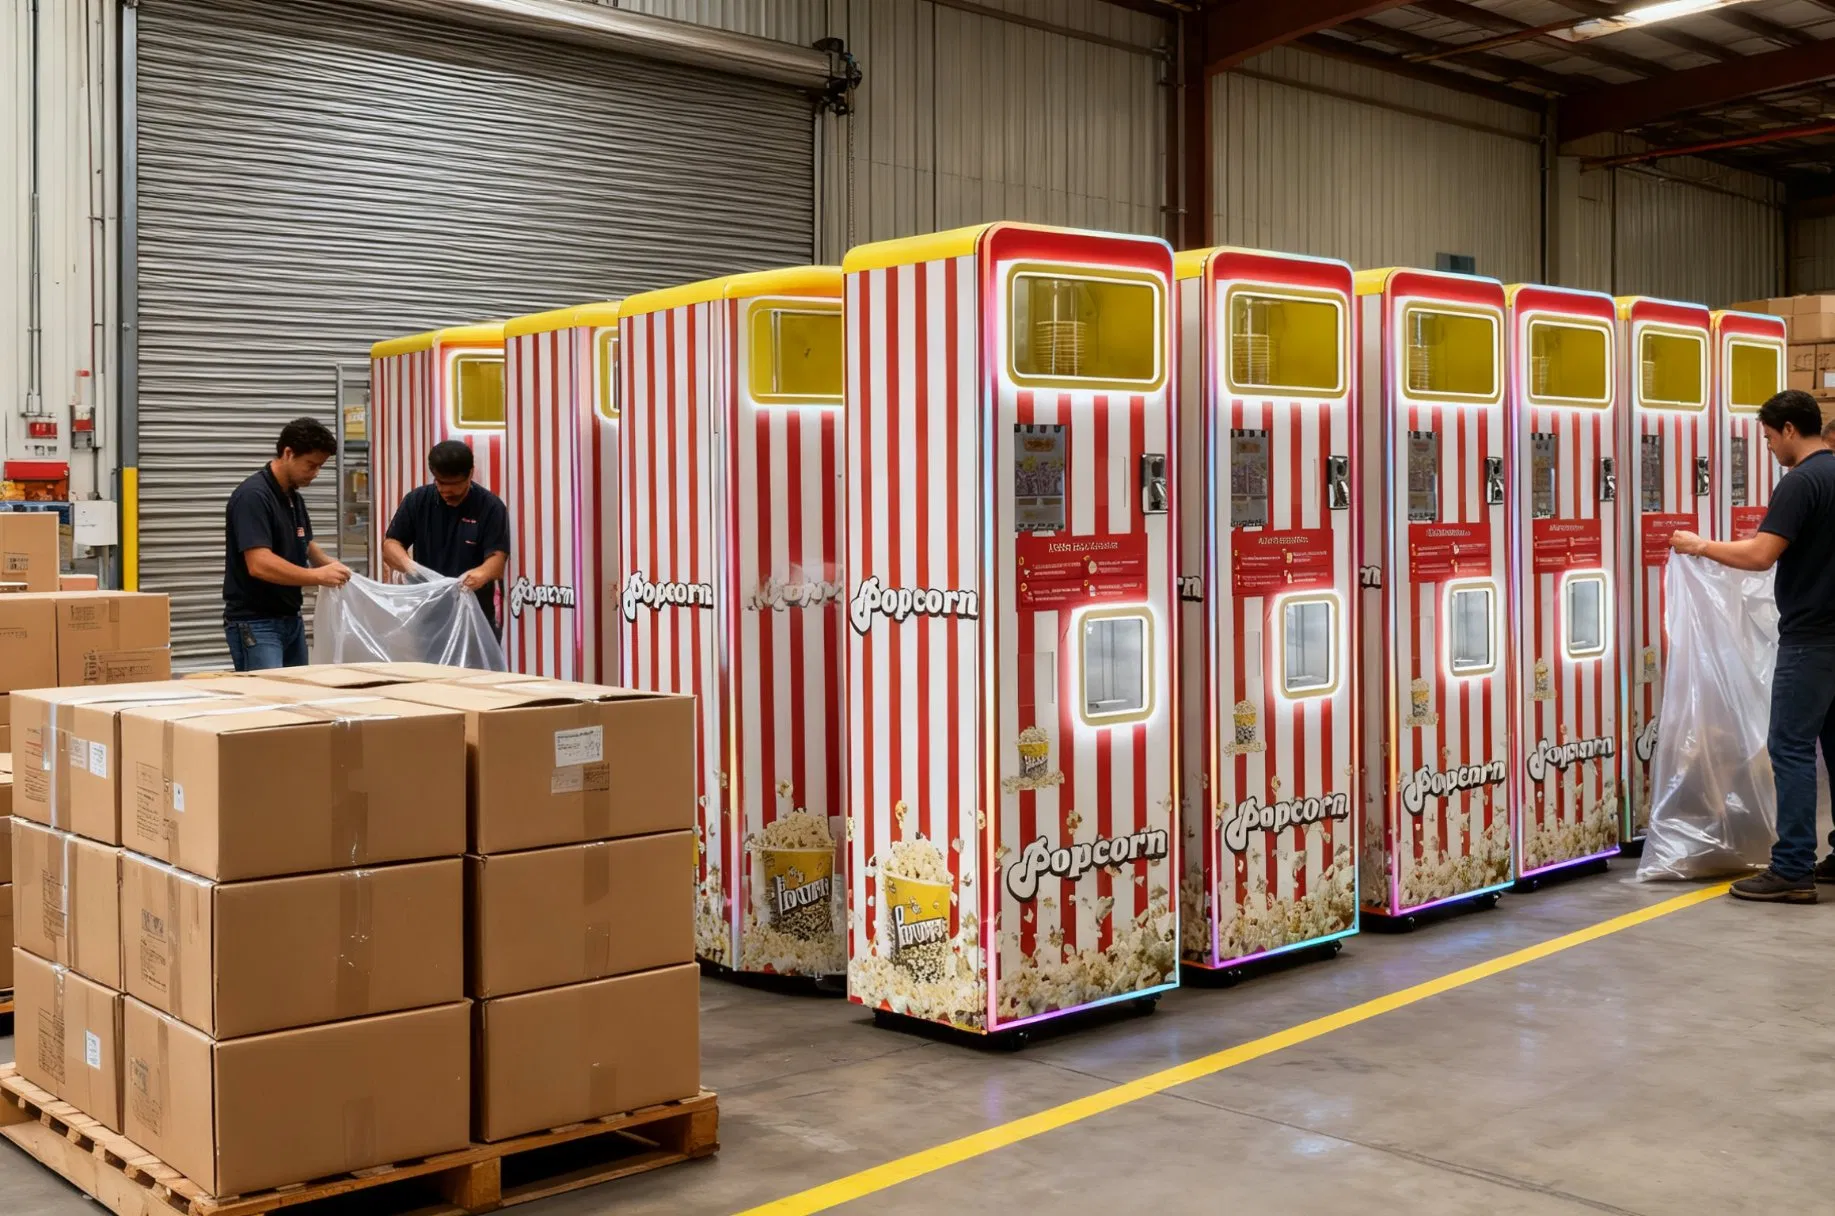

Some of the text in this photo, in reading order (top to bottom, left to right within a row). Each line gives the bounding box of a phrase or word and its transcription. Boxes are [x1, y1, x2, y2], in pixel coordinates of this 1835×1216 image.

[622, 571, 714, 622] Popcorn
[850, 576, 978, 636] Popcorn
[1224, 793, 1349, 854] Popcorn
[1007, 830, 1168, 903] Popcorn
